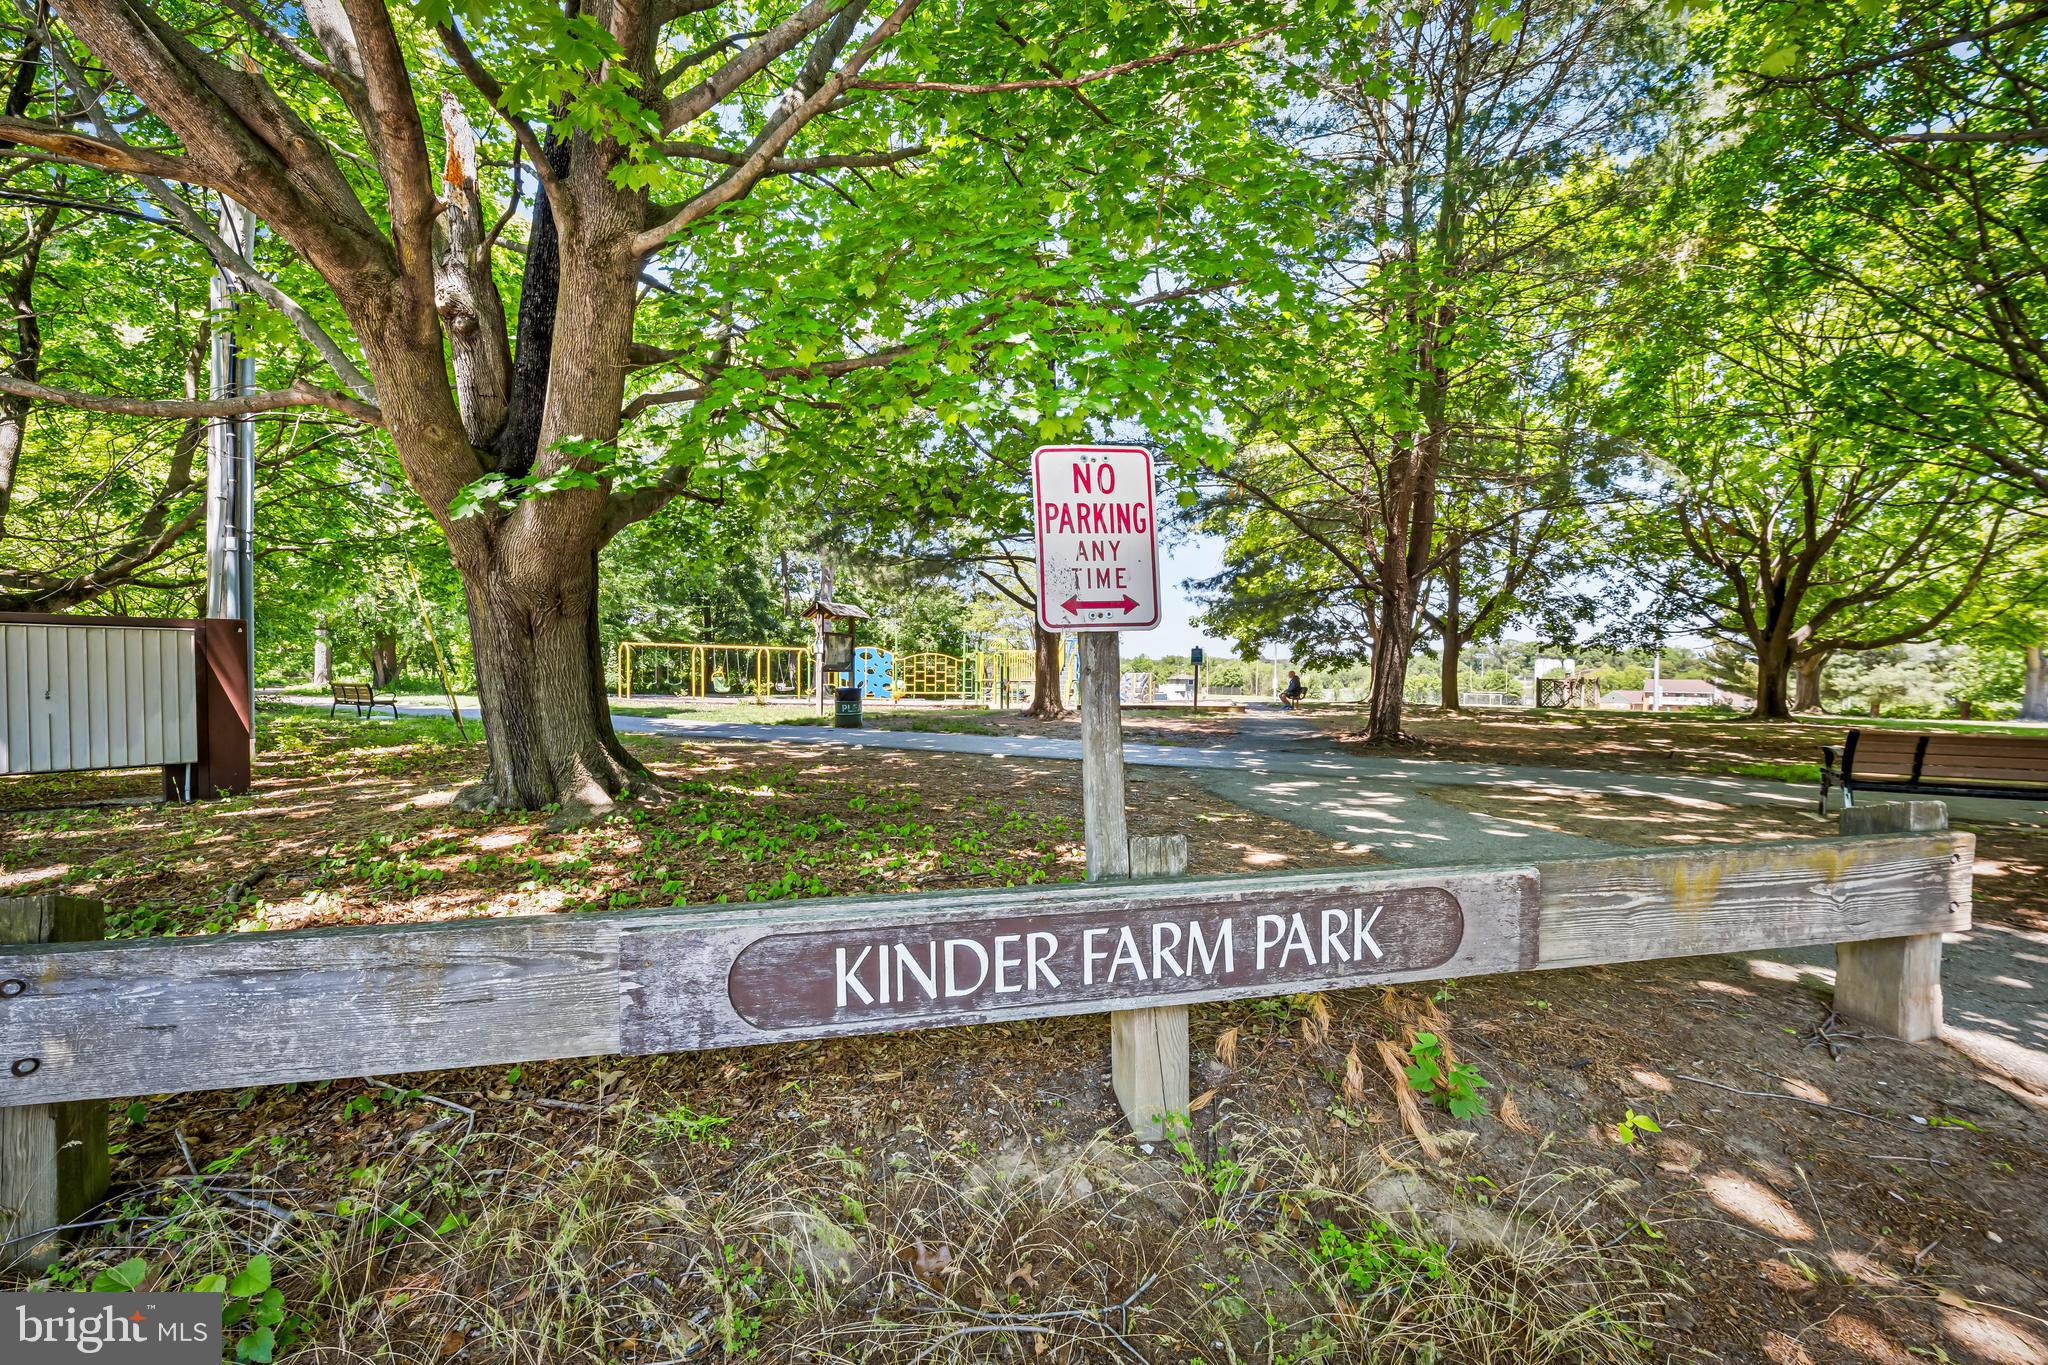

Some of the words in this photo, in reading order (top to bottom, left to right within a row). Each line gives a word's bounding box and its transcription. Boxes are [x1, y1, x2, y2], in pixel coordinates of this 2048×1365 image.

[1073, 463, 1115, 494] NO
[1045, 502, 1147, 534] PARKING
[1076, 540, 1120, 562] ANY
[1071, 567, 1128, 589] TIME
[836, 931, 1061, 1008] KINDER
[1083, 917, 1234, 985] FARM
[1256, 905, 1385, 971] PARK
